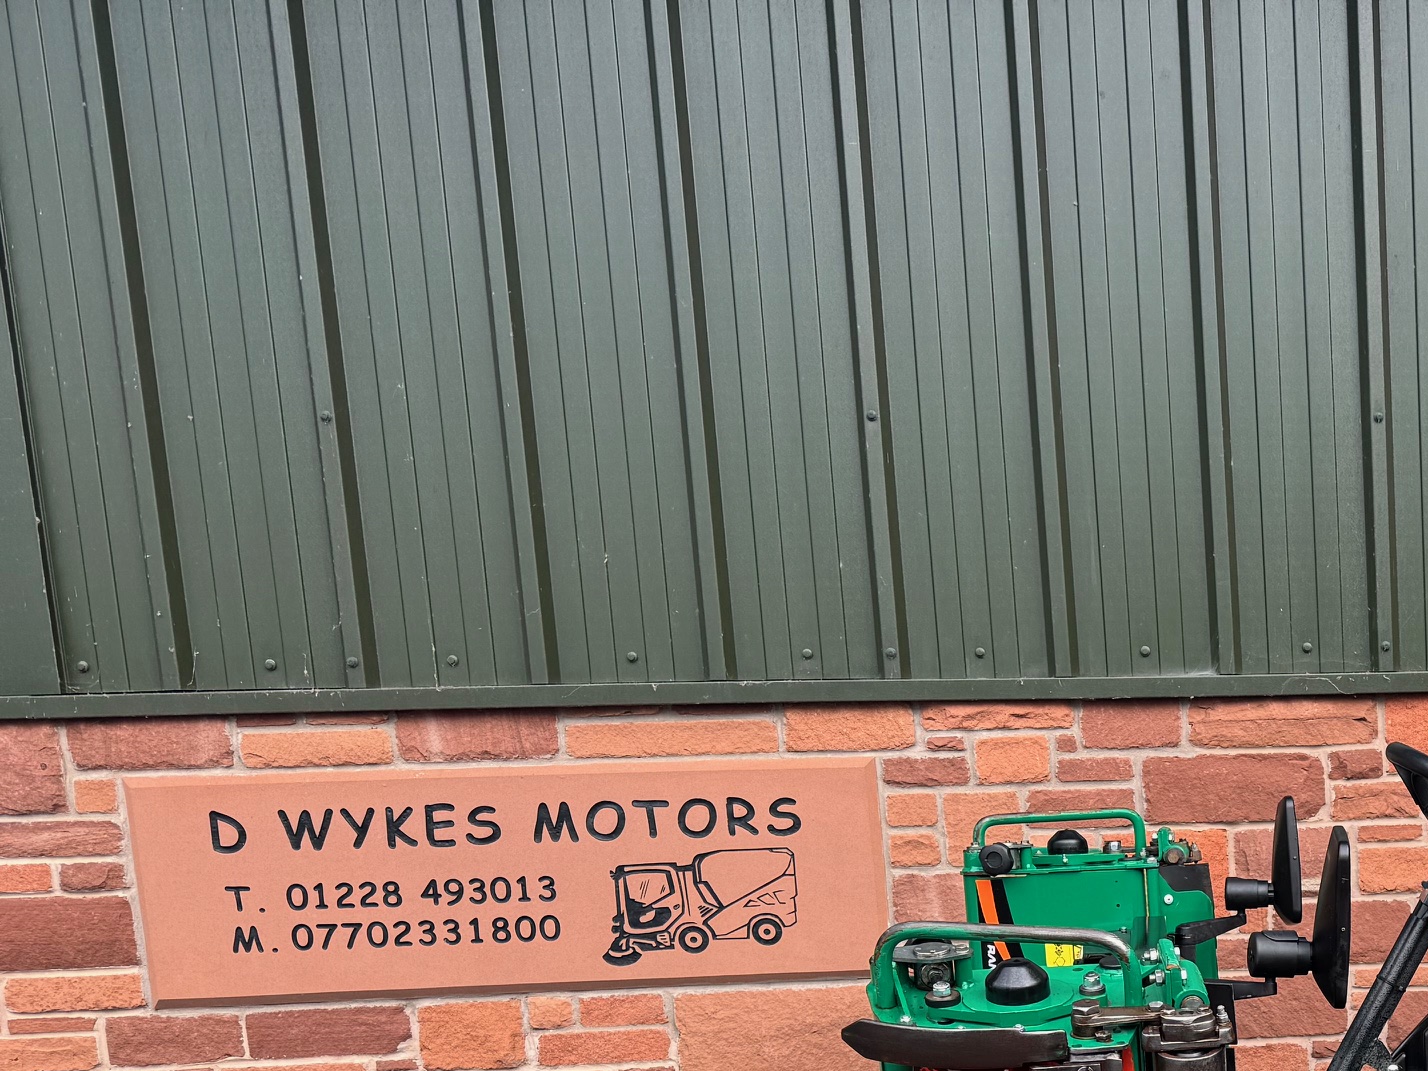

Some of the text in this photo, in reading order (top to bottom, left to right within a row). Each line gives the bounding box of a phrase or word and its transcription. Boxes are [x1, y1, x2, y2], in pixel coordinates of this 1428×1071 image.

[209, 796, 802, 854] D WYKES MOTORS
[225, 875, 557, 912] T. 01228 493013
[232, 914, 561, 954] M. 07702331800
